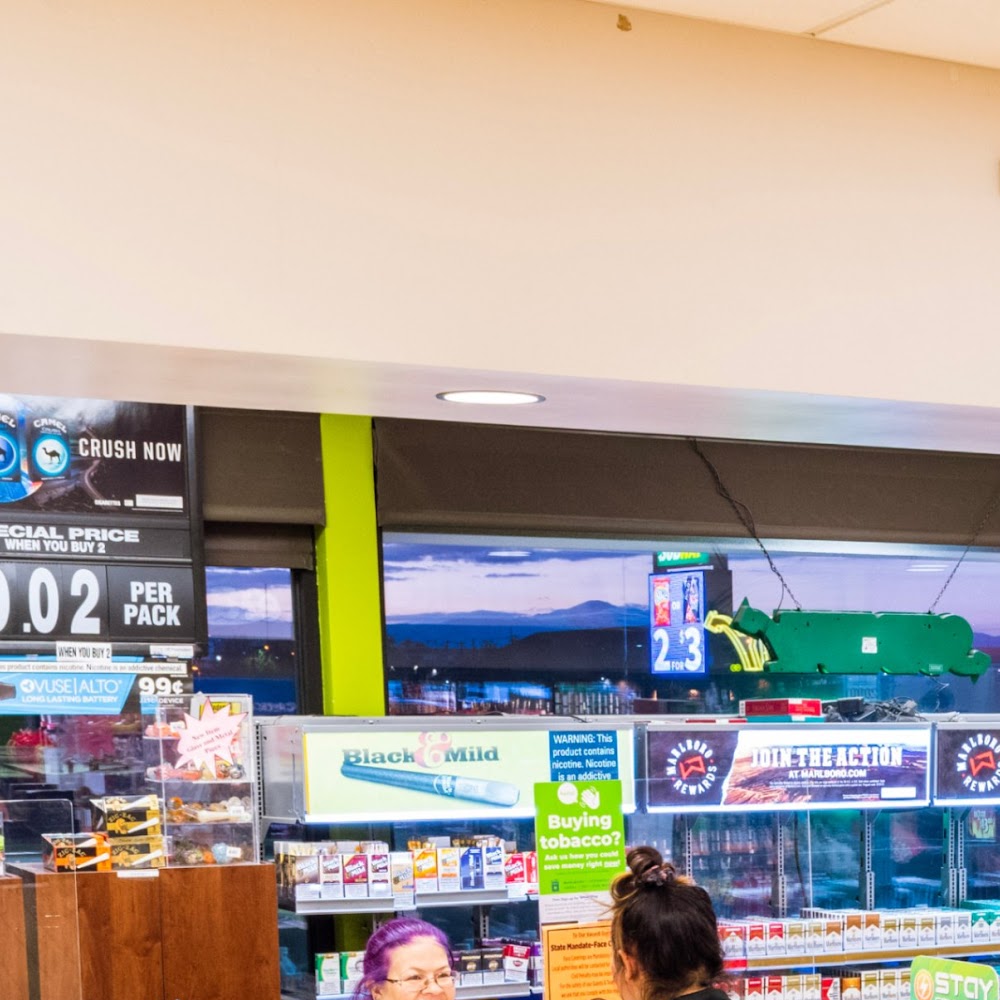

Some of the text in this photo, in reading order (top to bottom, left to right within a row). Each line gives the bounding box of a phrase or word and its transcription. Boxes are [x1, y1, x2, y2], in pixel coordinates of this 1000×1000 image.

[79, 438, 182, 462] CRUSH NOW
[69, 527, 140, 543] PRICE
[5, 539, 106, 554] WHEN YOU BUY 2
[130, 582, 173, 603] PER
[123, 605, 181, 626] PACK
[58, 647, 77, 658] WHEN
[78, 647, 91, 658] YOU
[92, 647, 105, 658] BUY
[653, 628, 670, 671] 2
[671, 661, 685, 671] FOR
[35, 679, 119, 694] VUSE ALTO
[138, 677, 184, 695] 99¢
[553, 733, 613, 744] WARNING: This
[341, 731, 500, 768] Black & Mild
[552, 746, 615, 757] product contains
[666, 739, 713, 776] MARLBORO
[750, 744, 903, 767] JOIN THE ACTION
[552, 759, 616, 769] nicotine. Nicotine
[558, 772, 611, 782] is an addictive
[672, 765, 718, 796] REWARDS
[788, 768, 867, 779] AT MARLBORO.COM
[548, 812, 612, 832] Buying
[540, 831, 621, 850] tobacco?
[545, 853, 558, 861] Ask
[569, 852, 584, 861] how
[585, 853, 598, 862] you
[600, 851, 619, 859] could
[561, 861, 584, 870] money
[586, 860, 602, 870] right
[551, 944, 566, 952] State
[567, 940, 607, 950] Mandate-Face
